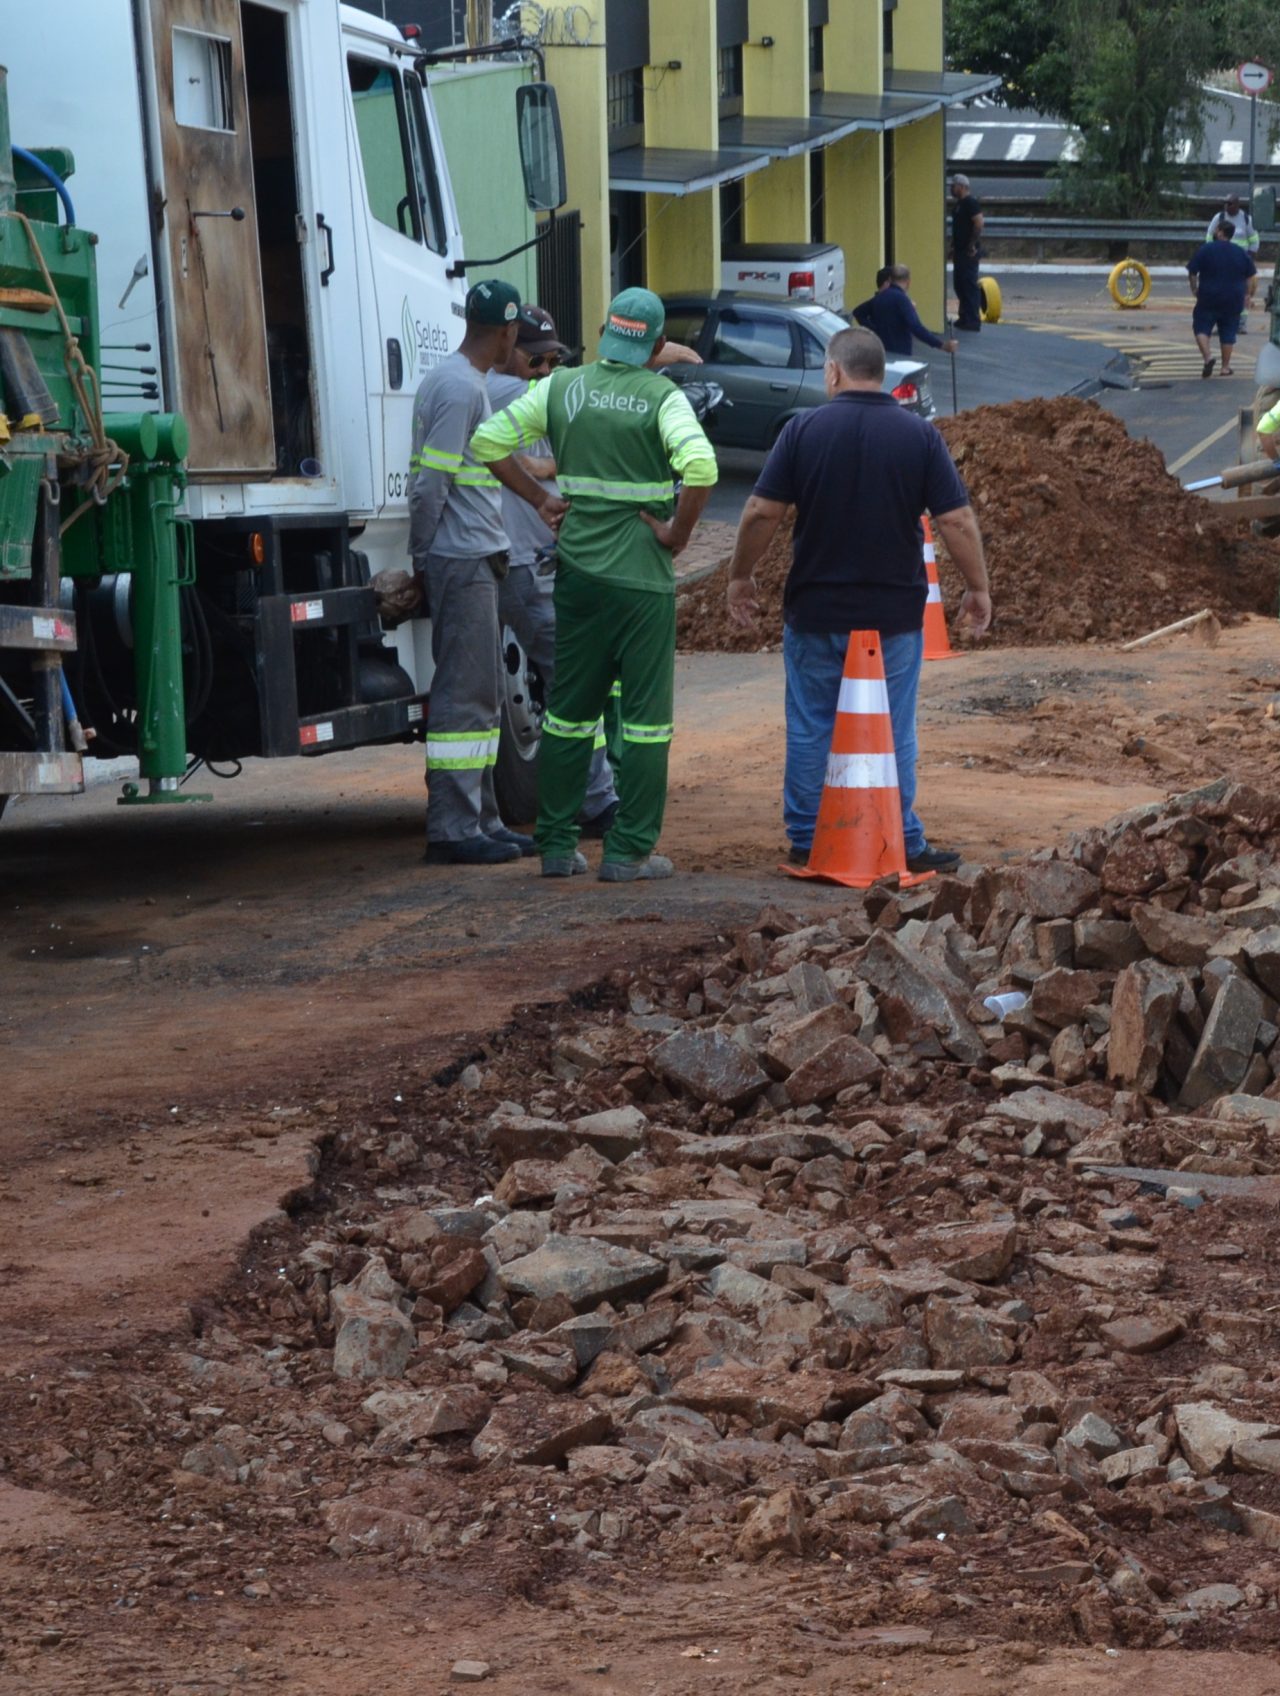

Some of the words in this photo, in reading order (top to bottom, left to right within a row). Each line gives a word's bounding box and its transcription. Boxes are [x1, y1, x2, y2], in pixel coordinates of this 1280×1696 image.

[415, 319, 448, 352] Seleta
[588, 389, 648, 414] Seleta
[387, 472, 402, 498] CG
